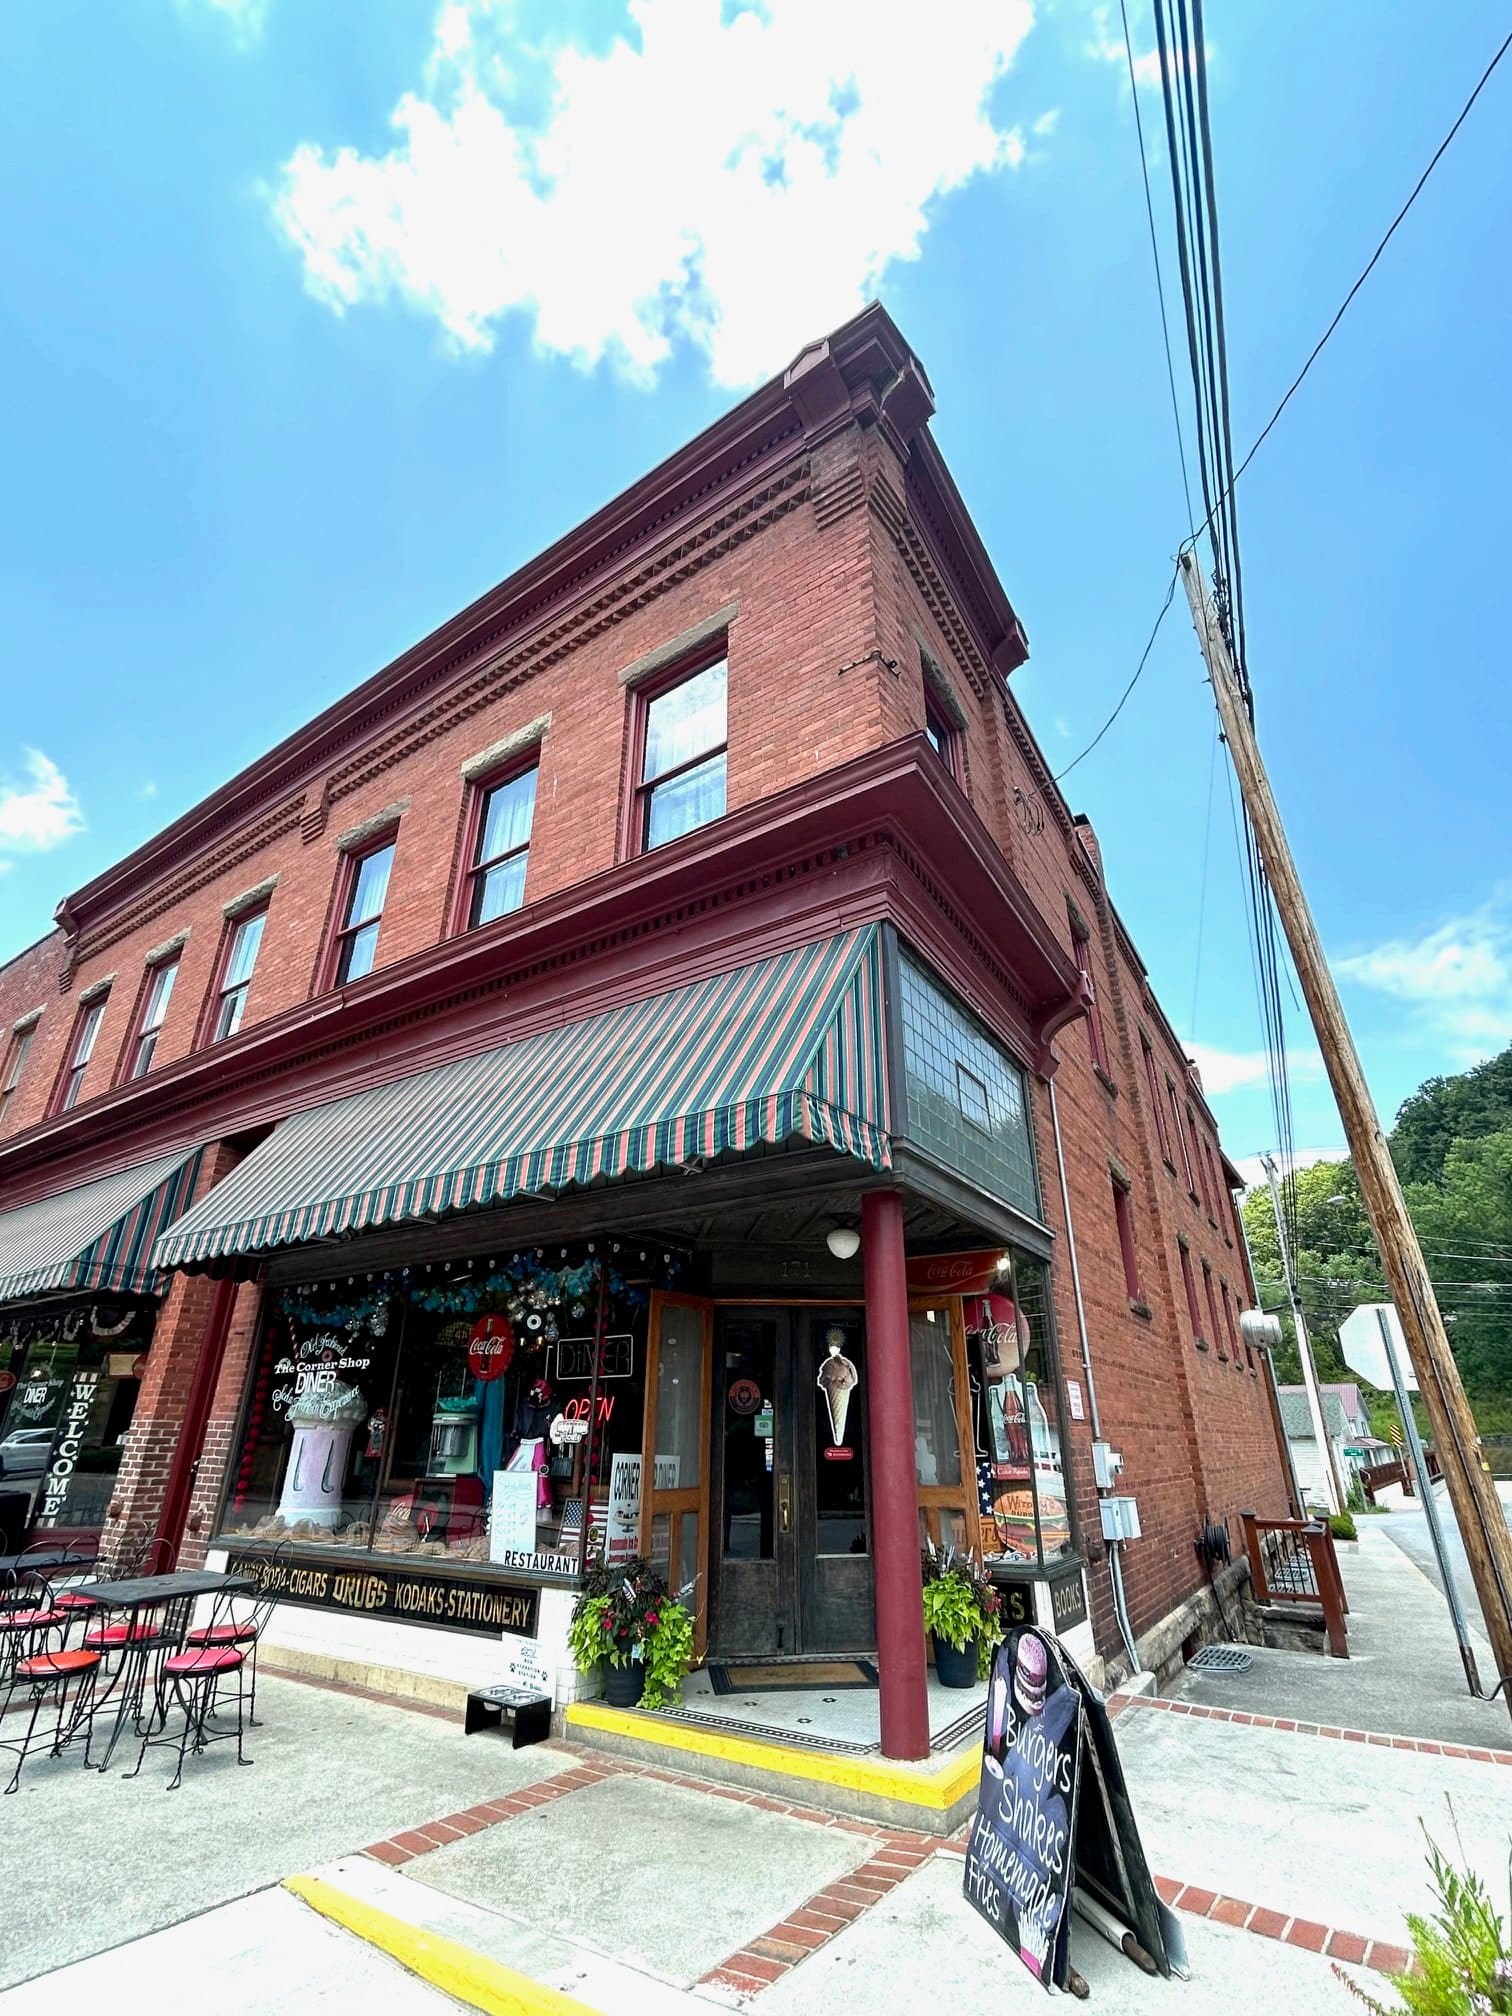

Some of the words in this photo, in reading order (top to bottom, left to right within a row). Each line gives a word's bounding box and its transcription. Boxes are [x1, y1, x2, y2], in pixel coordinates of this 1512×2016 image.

[781, 1261, 812, 1278] 171
[469, 1335, 506, 1356] Coca-Cola
[274, 1364, 296, 1374] The
[296, 1360, 338, 1372] Corner
[338, 1357, 371, 1369] Shop
[295, 1370, 337, 1394] DINER
[22, 1386, 48, 1404] DINER
[40, 1383, 98, 1516] WELCOME
[614, 1461, 641, 1500] CORNER
[504, 1549, 578, 1574] RESTAURANT
[332, 1573, 388, 1609] DRUGS
[1054, 1582, 1082, 1618] BOOKS
[1005, 1702, 1072, 1793] Burgers
[999, 1775, 1065, 1875] Shakes
[968, 1854, 1001, 1921] Fries
[974, 1813, 1056, 1928] Homemade
